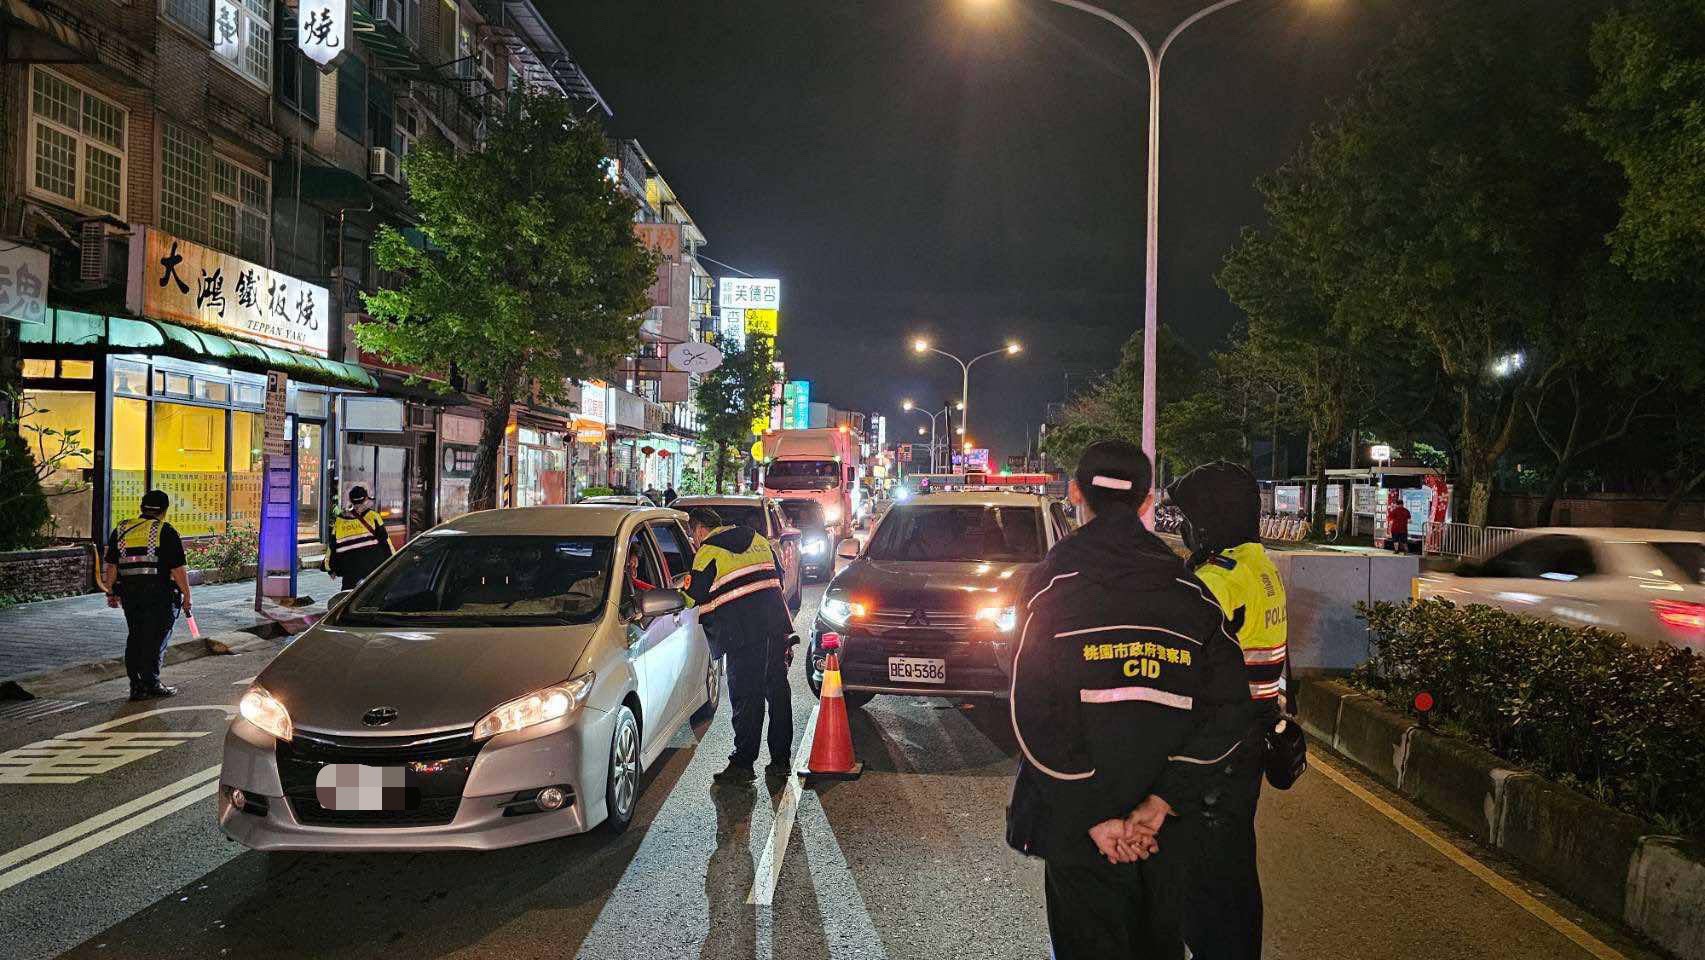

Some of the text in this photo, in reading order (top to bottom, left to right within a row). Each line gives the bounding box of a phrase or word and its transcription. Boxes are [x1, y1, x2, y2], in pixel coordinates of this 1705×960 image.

[304, 8, 339, 47] 燒
[159, 240, 318, 330] 大鴻鐵板燒
[247, 319, 306, 342] TEPPAN YAKI
[1083, 641, 1191, 666] 桃園市政府警察局
[891, 663, 944, 680] BEQ-5386
[1123, 658, 1160, 679] CID
